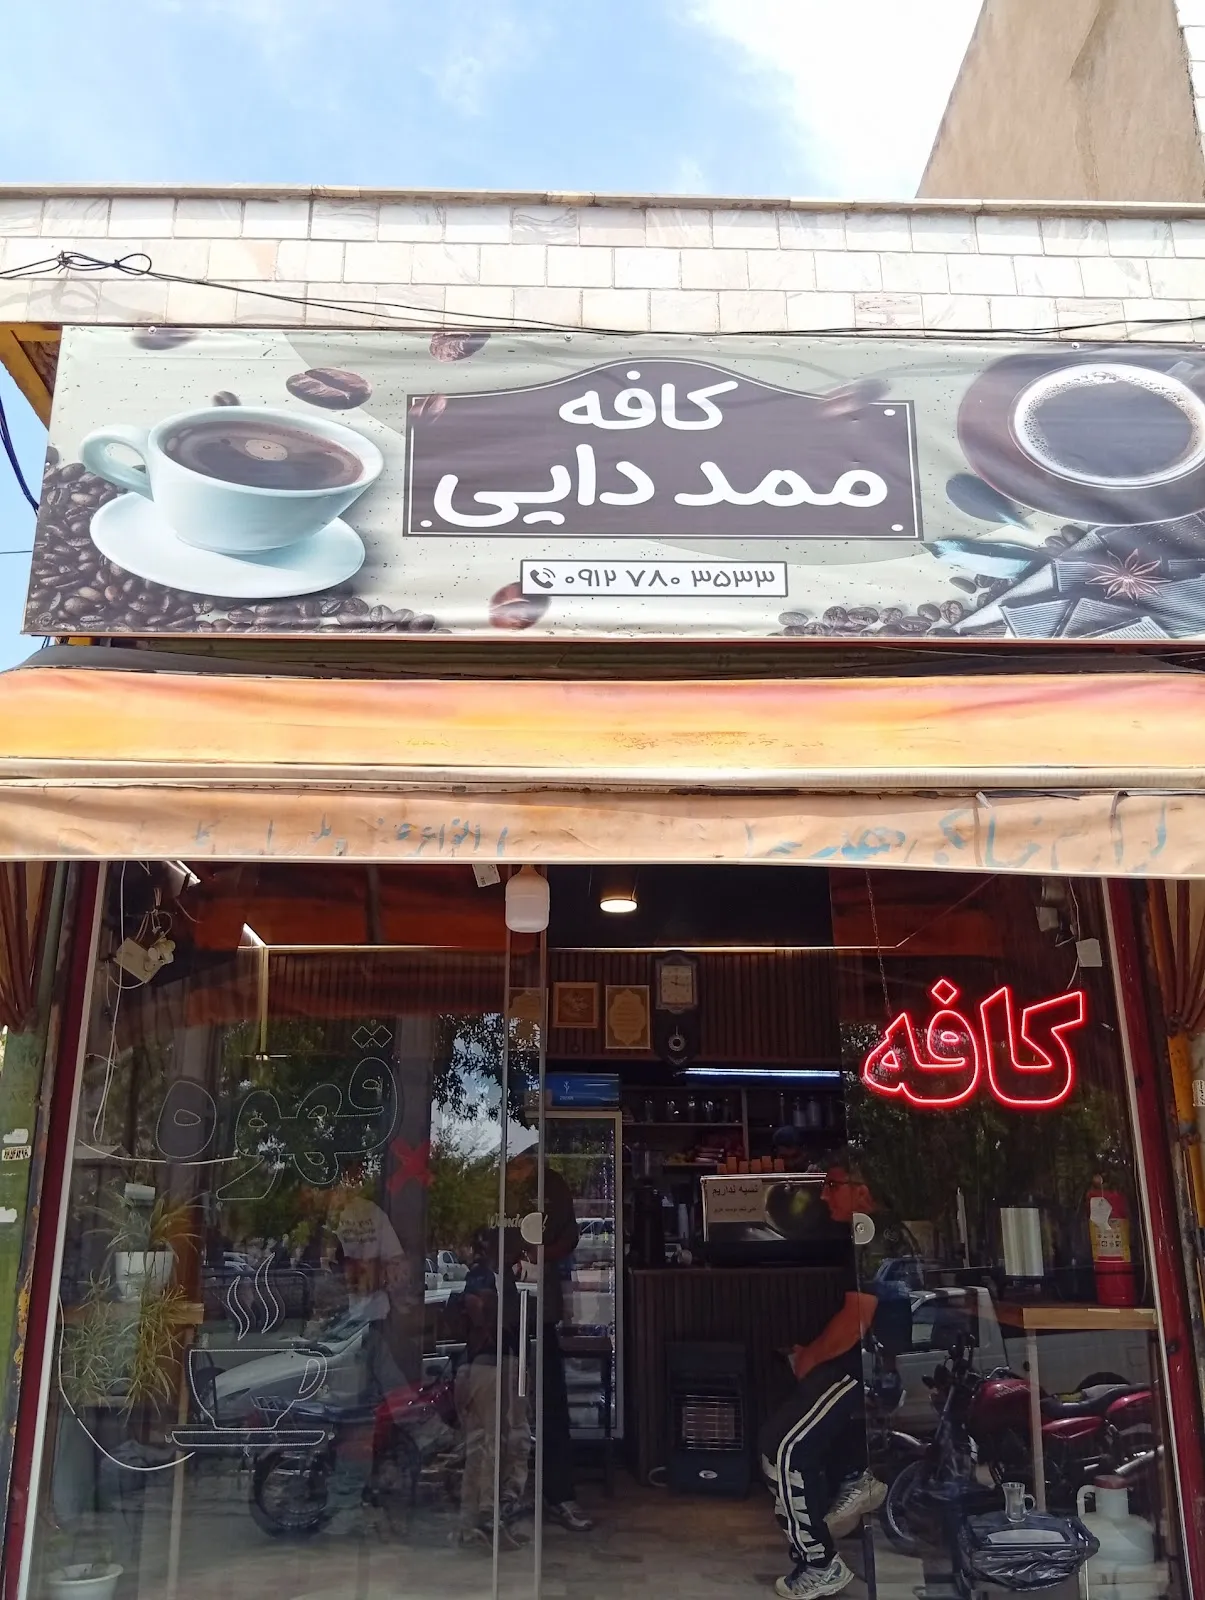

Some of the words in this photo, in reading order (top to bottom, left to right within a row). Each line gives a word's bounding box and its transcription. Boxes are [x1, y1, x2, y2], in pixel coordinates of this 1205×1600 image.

[558, 370, 739, 431] کافه
[433, 443, 655, 527] دایی
[674, 461, 888, 508] ممد
[565, 568, 617, 587] ۰۹۱۲
[625, 569, 680, 587] ۷۸۰
[691, 569, 775, 588] ۳۵۳۳
[862, 977, 1085, 1106] کافه
[156, 1025, 398, 1200] قهوه
